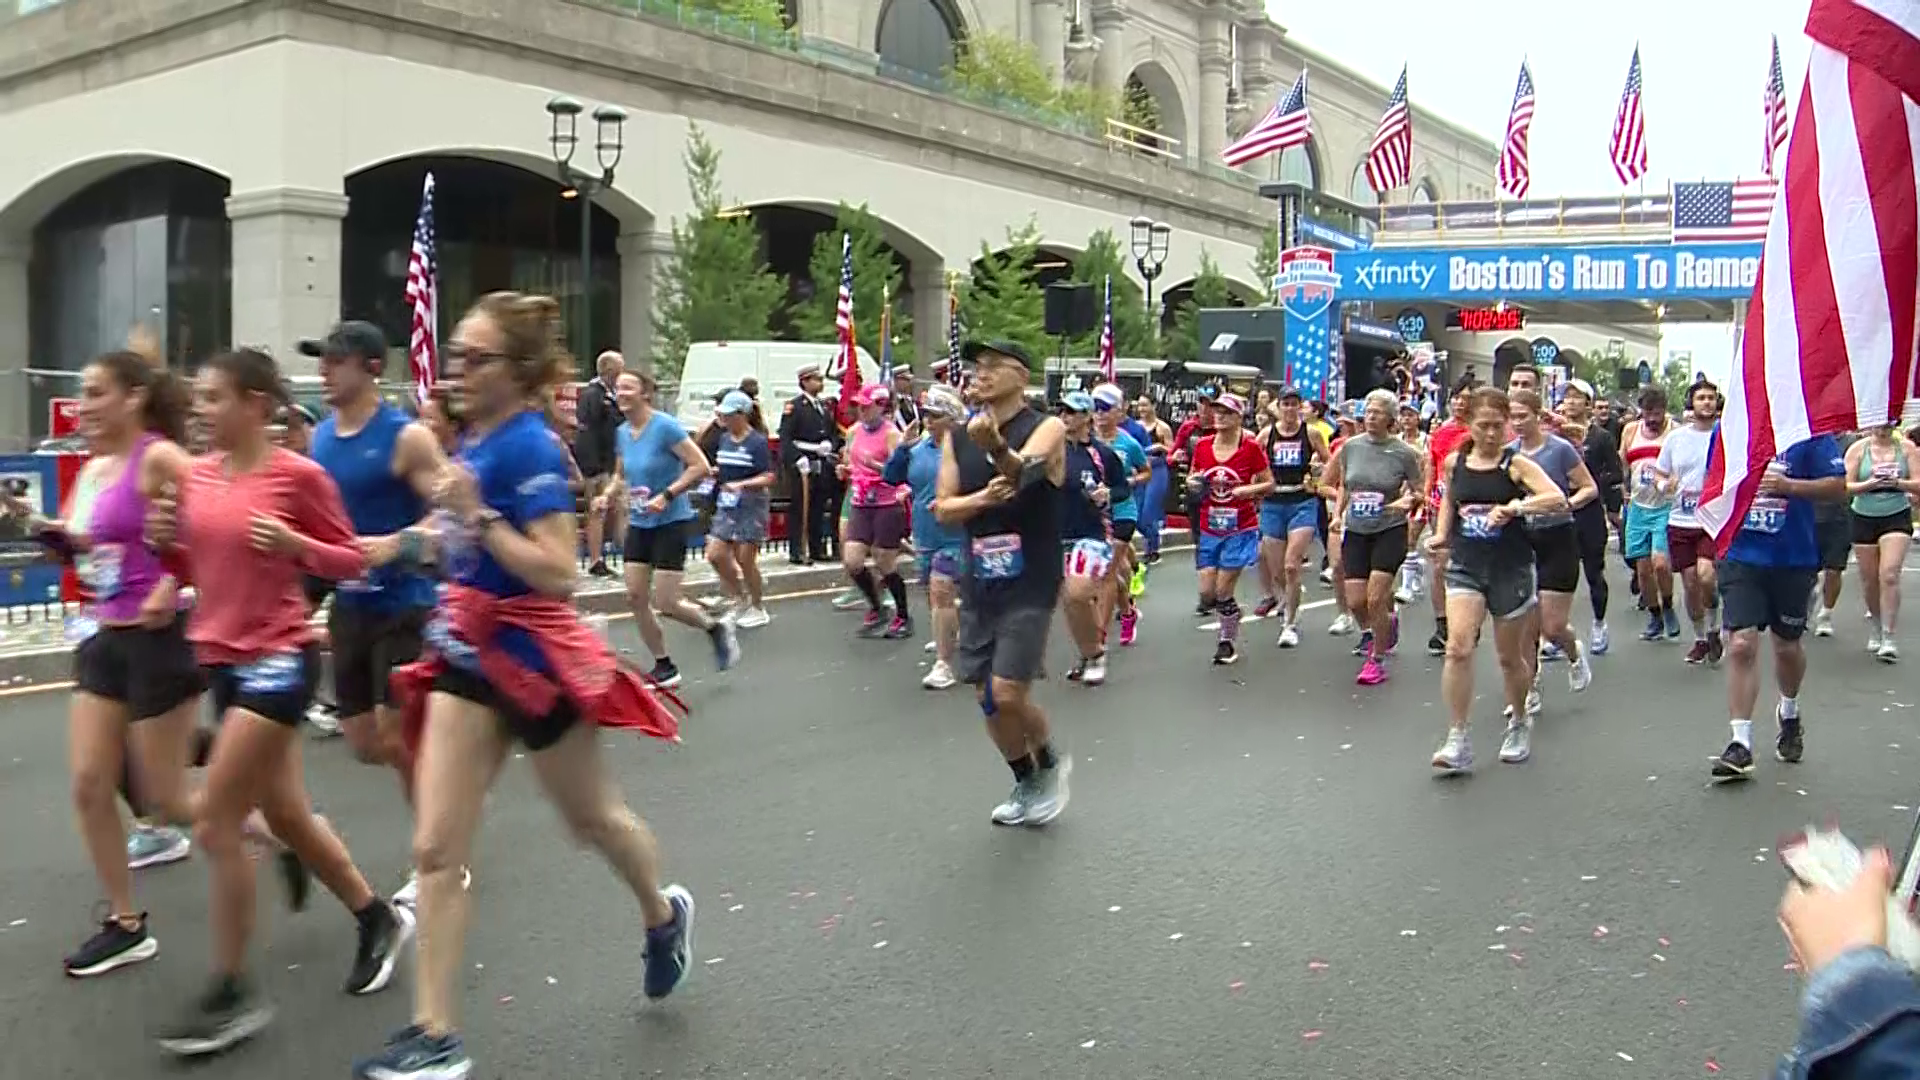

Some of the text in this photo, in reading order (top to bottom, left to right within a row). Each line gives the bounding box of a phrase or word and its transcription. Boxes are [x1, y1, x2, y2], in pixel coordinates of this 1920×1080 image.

[1354, 250, 1762, 292] xfinity Boston's Run To Reme
